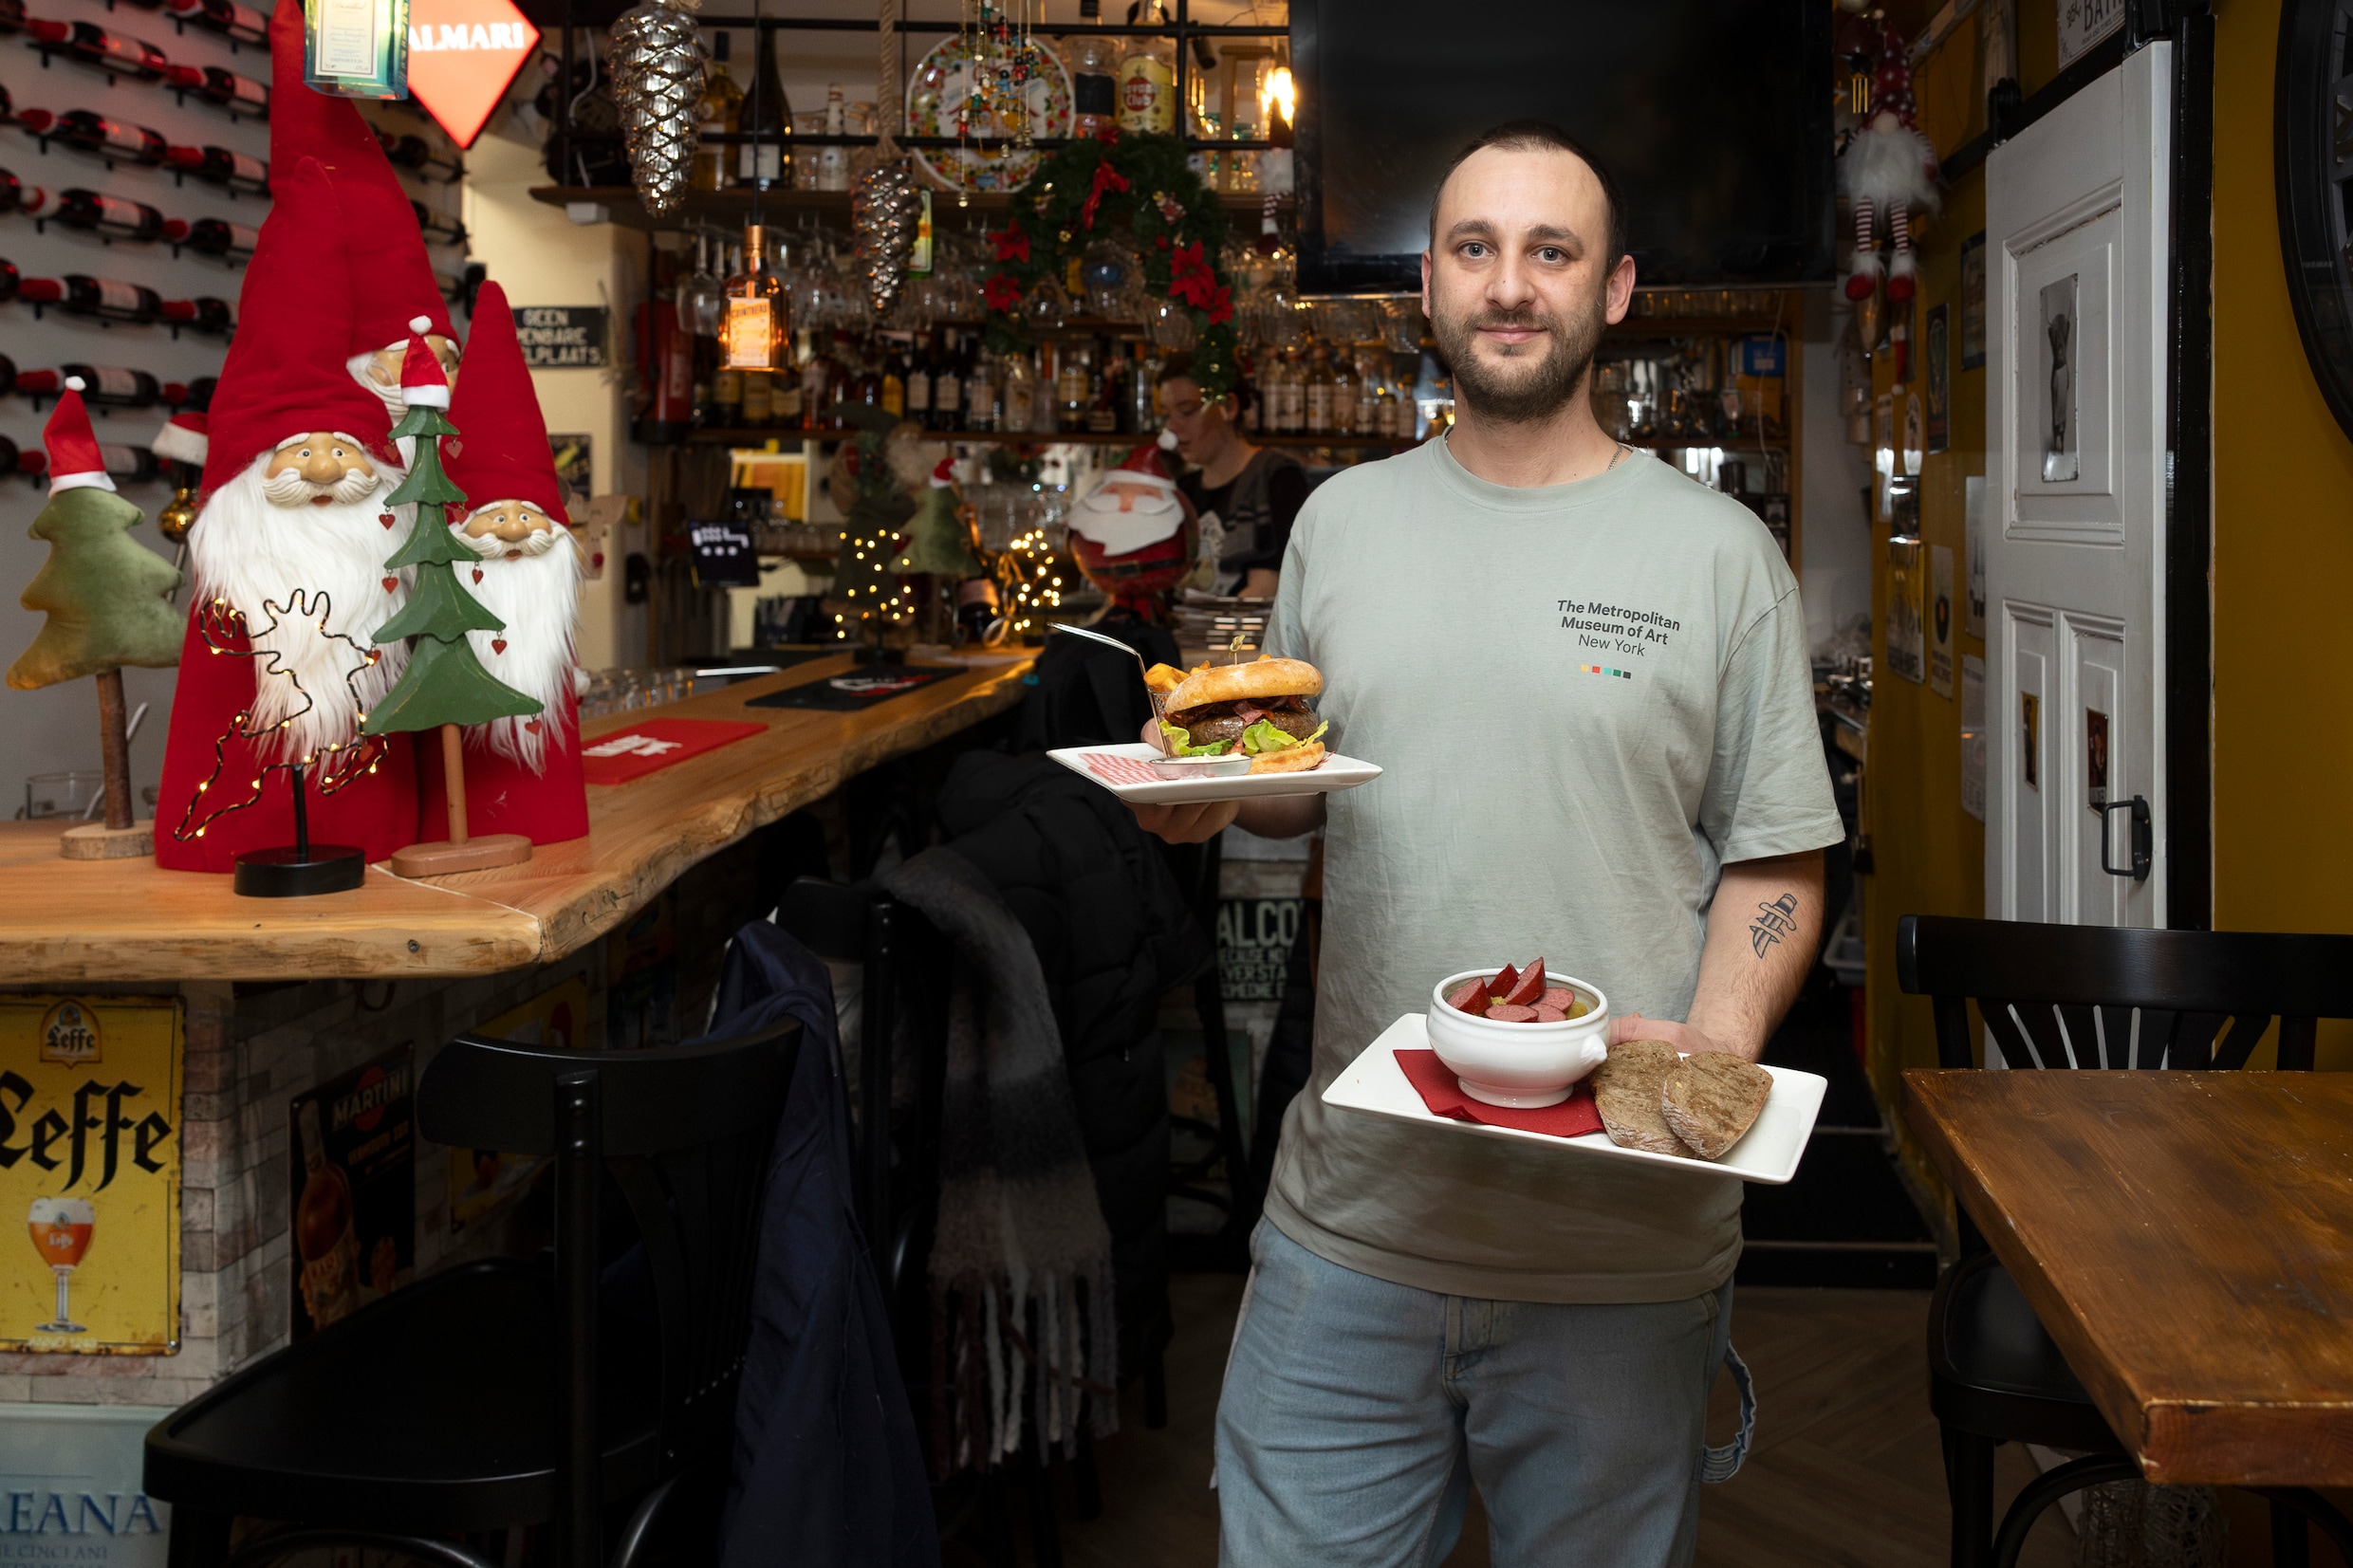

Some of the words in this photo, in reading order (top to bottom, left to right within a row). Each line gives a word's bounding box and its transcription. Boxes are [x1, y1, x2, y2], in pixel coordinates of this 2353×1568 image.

[522, 309, 568, 327] GEEN
[515, 327, 587, 346] PENBARE
[1557, 600, 1585, 614] The
[1587, 601, 1680, 632] Metropolitan
[1561, 616, 1624, 635] Museum
[1627, 625, 1643, 638] of
[1644, 628, 1668, 645] Art
[1578, 634, 1611, 650] New
[1615, 638, 1645, 656] York
[47, 1025, 95, 1053] Leffe
[332, 1068, 410, 1133] MARTINI
[0, 1070, 172, 1193] Leffe
